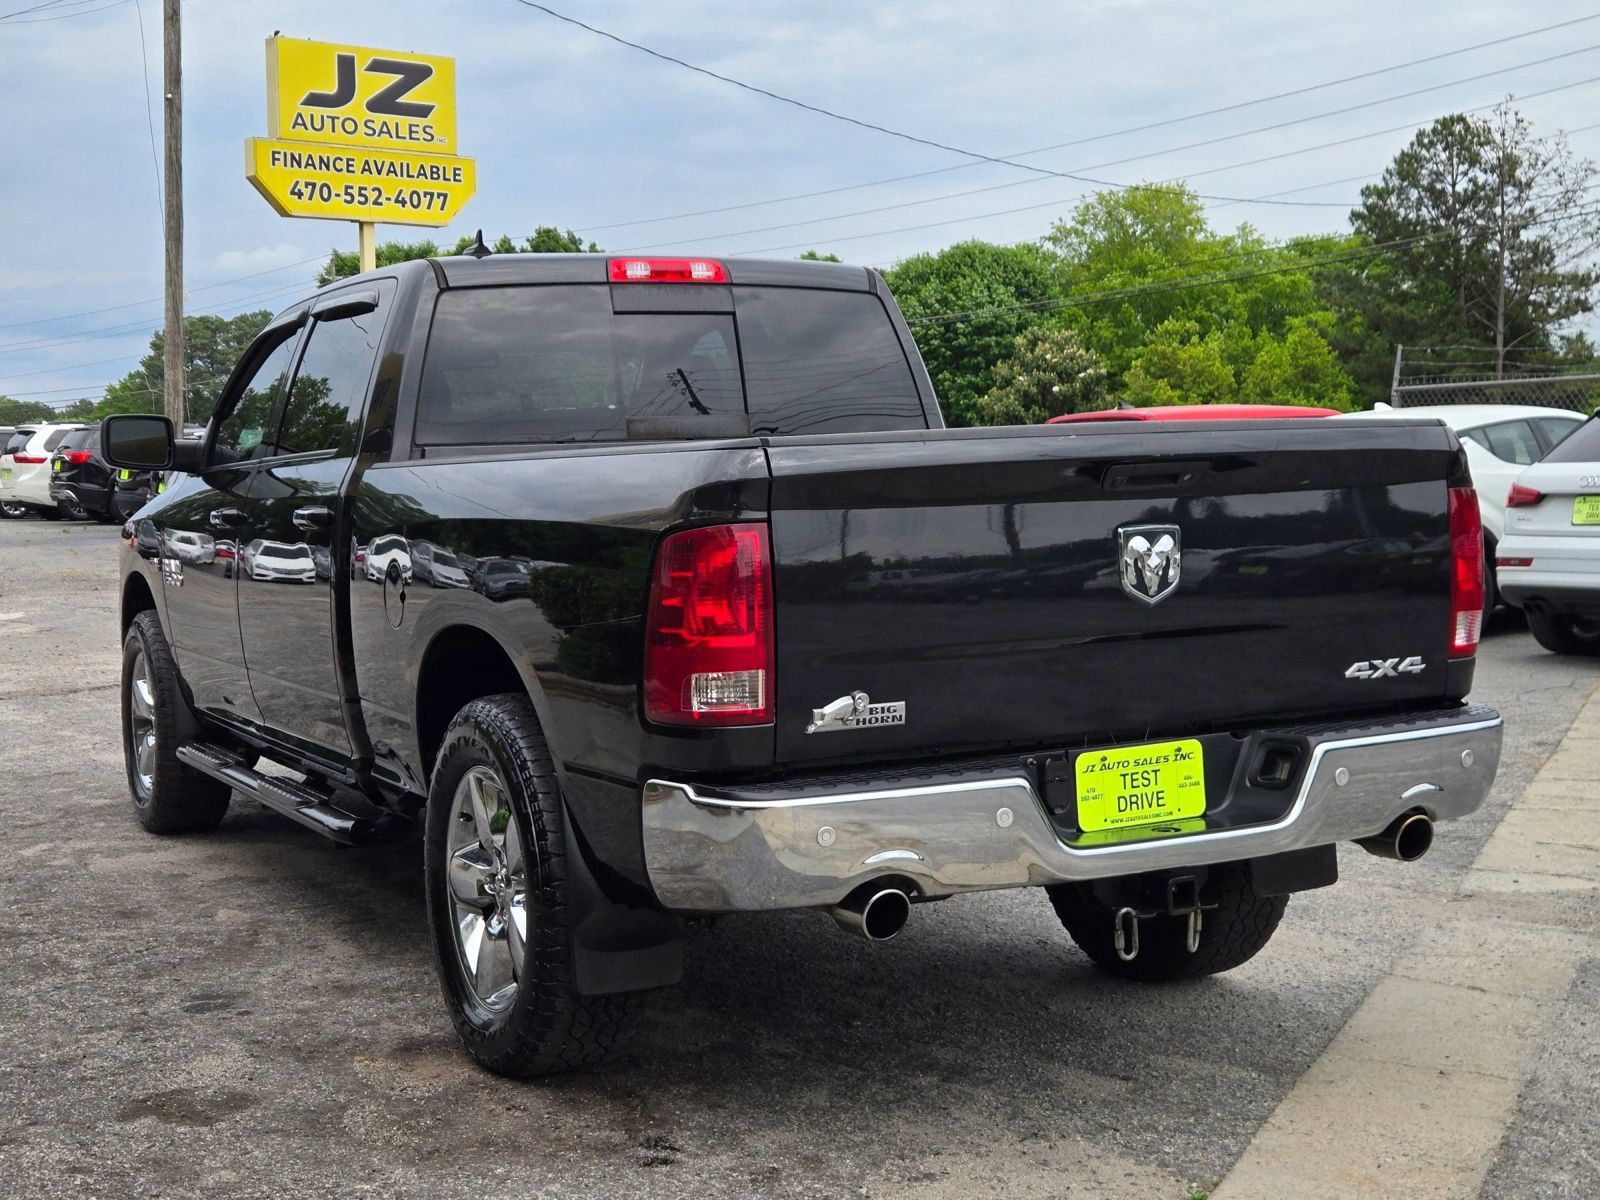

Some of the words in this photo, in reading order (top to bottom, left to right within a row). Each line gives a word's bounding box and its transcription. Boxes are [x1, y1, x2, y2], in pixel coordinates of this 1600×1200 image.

[299, 53, 437, 119] JZ
[291, 112, 359, 135] AUTO
[363, 119, 435, 143] SALES
[271, 150, 356, 174] FINANCE
[360, 159, 463, 183] AVAILABLE
[289, 180, 449, 211] 470-552-4077
[855, 714, 903, 726] HORN
[869, 705, 898, 716] BIG
[1082, 764, 1097, 774] JZ
[1100, 760, 1130, 771] AUTO
[1133, 755, 1170, 768] SALES
[1119, 769, 1161, 790] TEST
[1117, 790, 1167, 813] DRIVE
